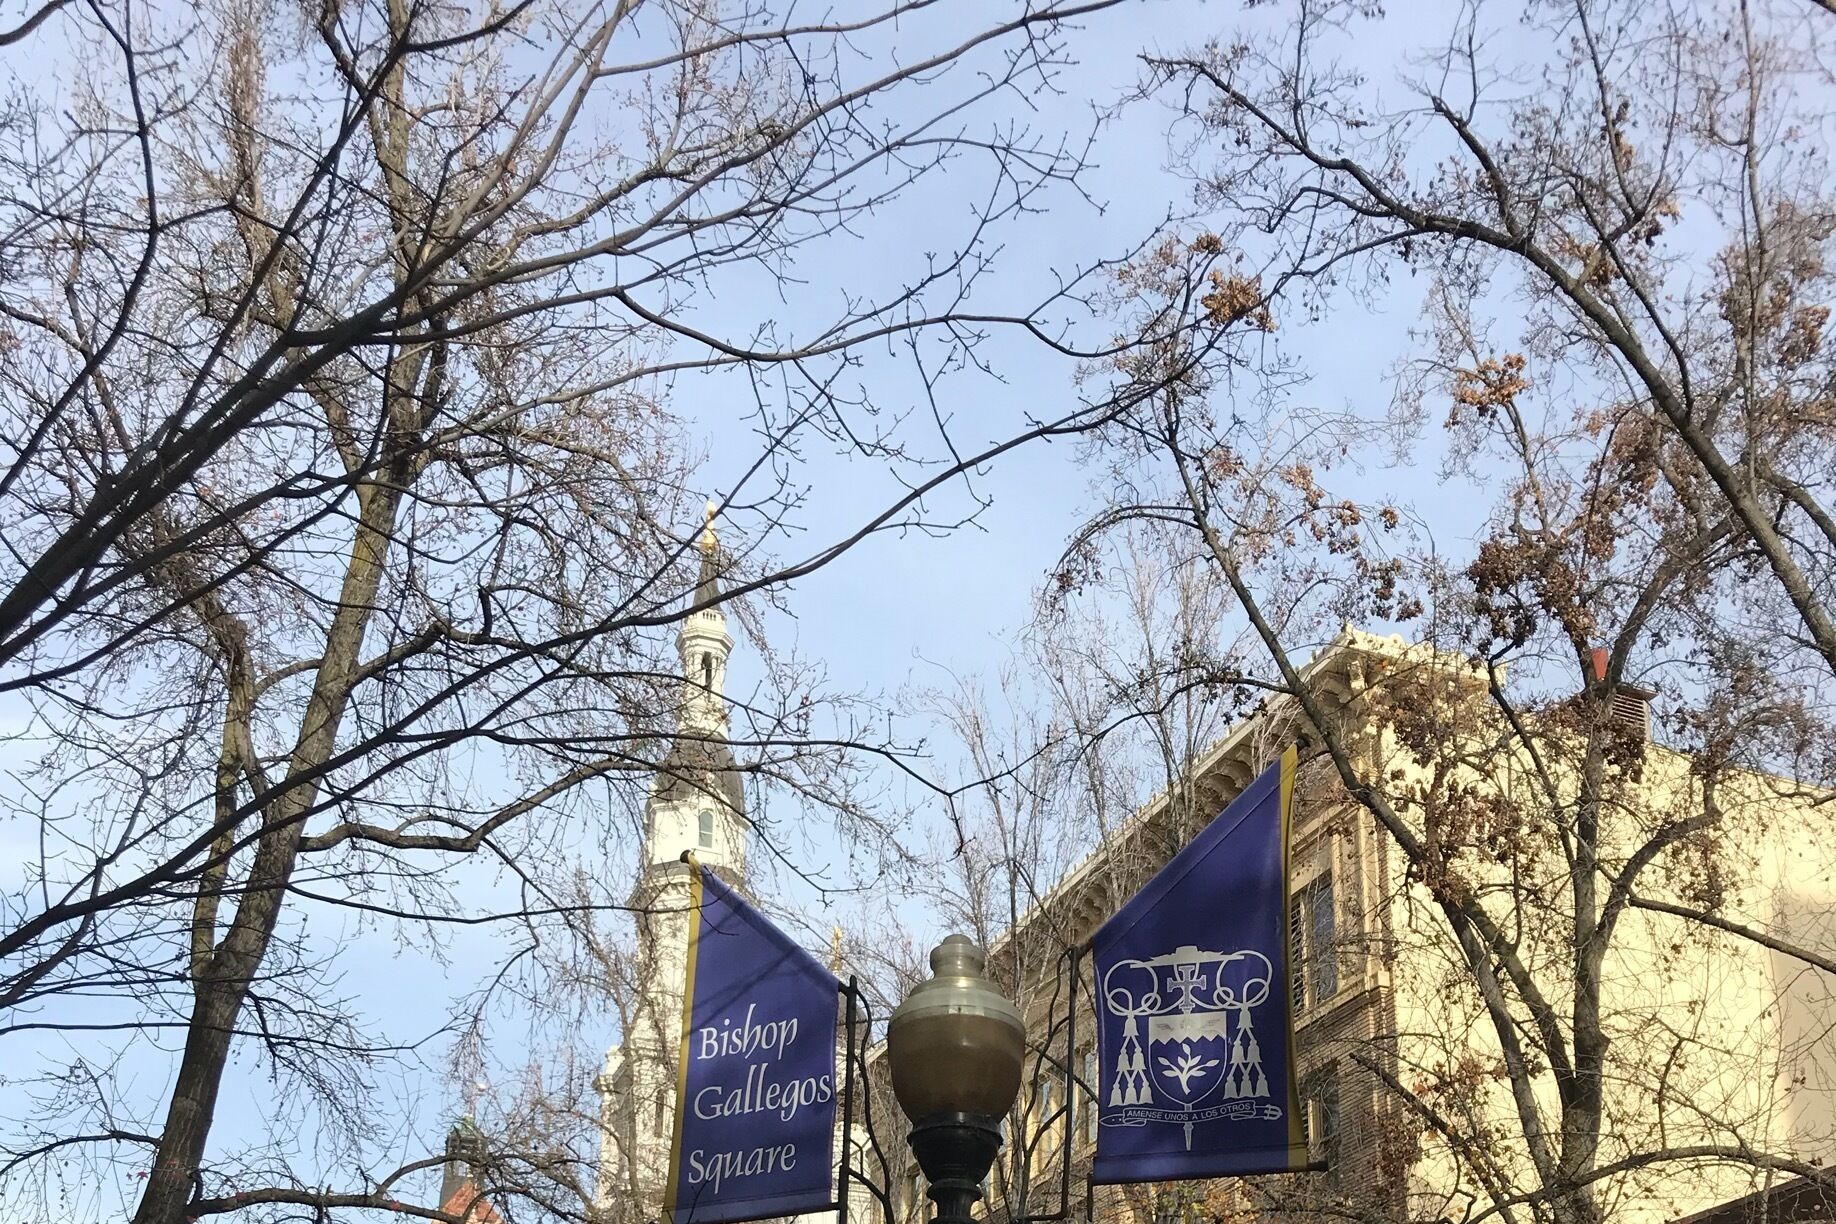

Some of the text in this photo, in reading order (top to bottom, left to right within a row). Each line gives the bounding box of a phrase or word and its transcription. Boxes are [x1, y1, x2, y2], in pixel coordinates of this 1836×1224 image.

[697, 1003, 798, 1060] Bishop
[694, 1062, 832, 1122] Gallegos
[1126, 1110, 1163, 1119] AMENSE
[1164, 1113, 1189, 1121] UNOS
[1201, 1109, 1218, 1119] LOS
[1220, 1103, 1251, 1114] OTROS
[688, 1143, 797, 1194] Square
